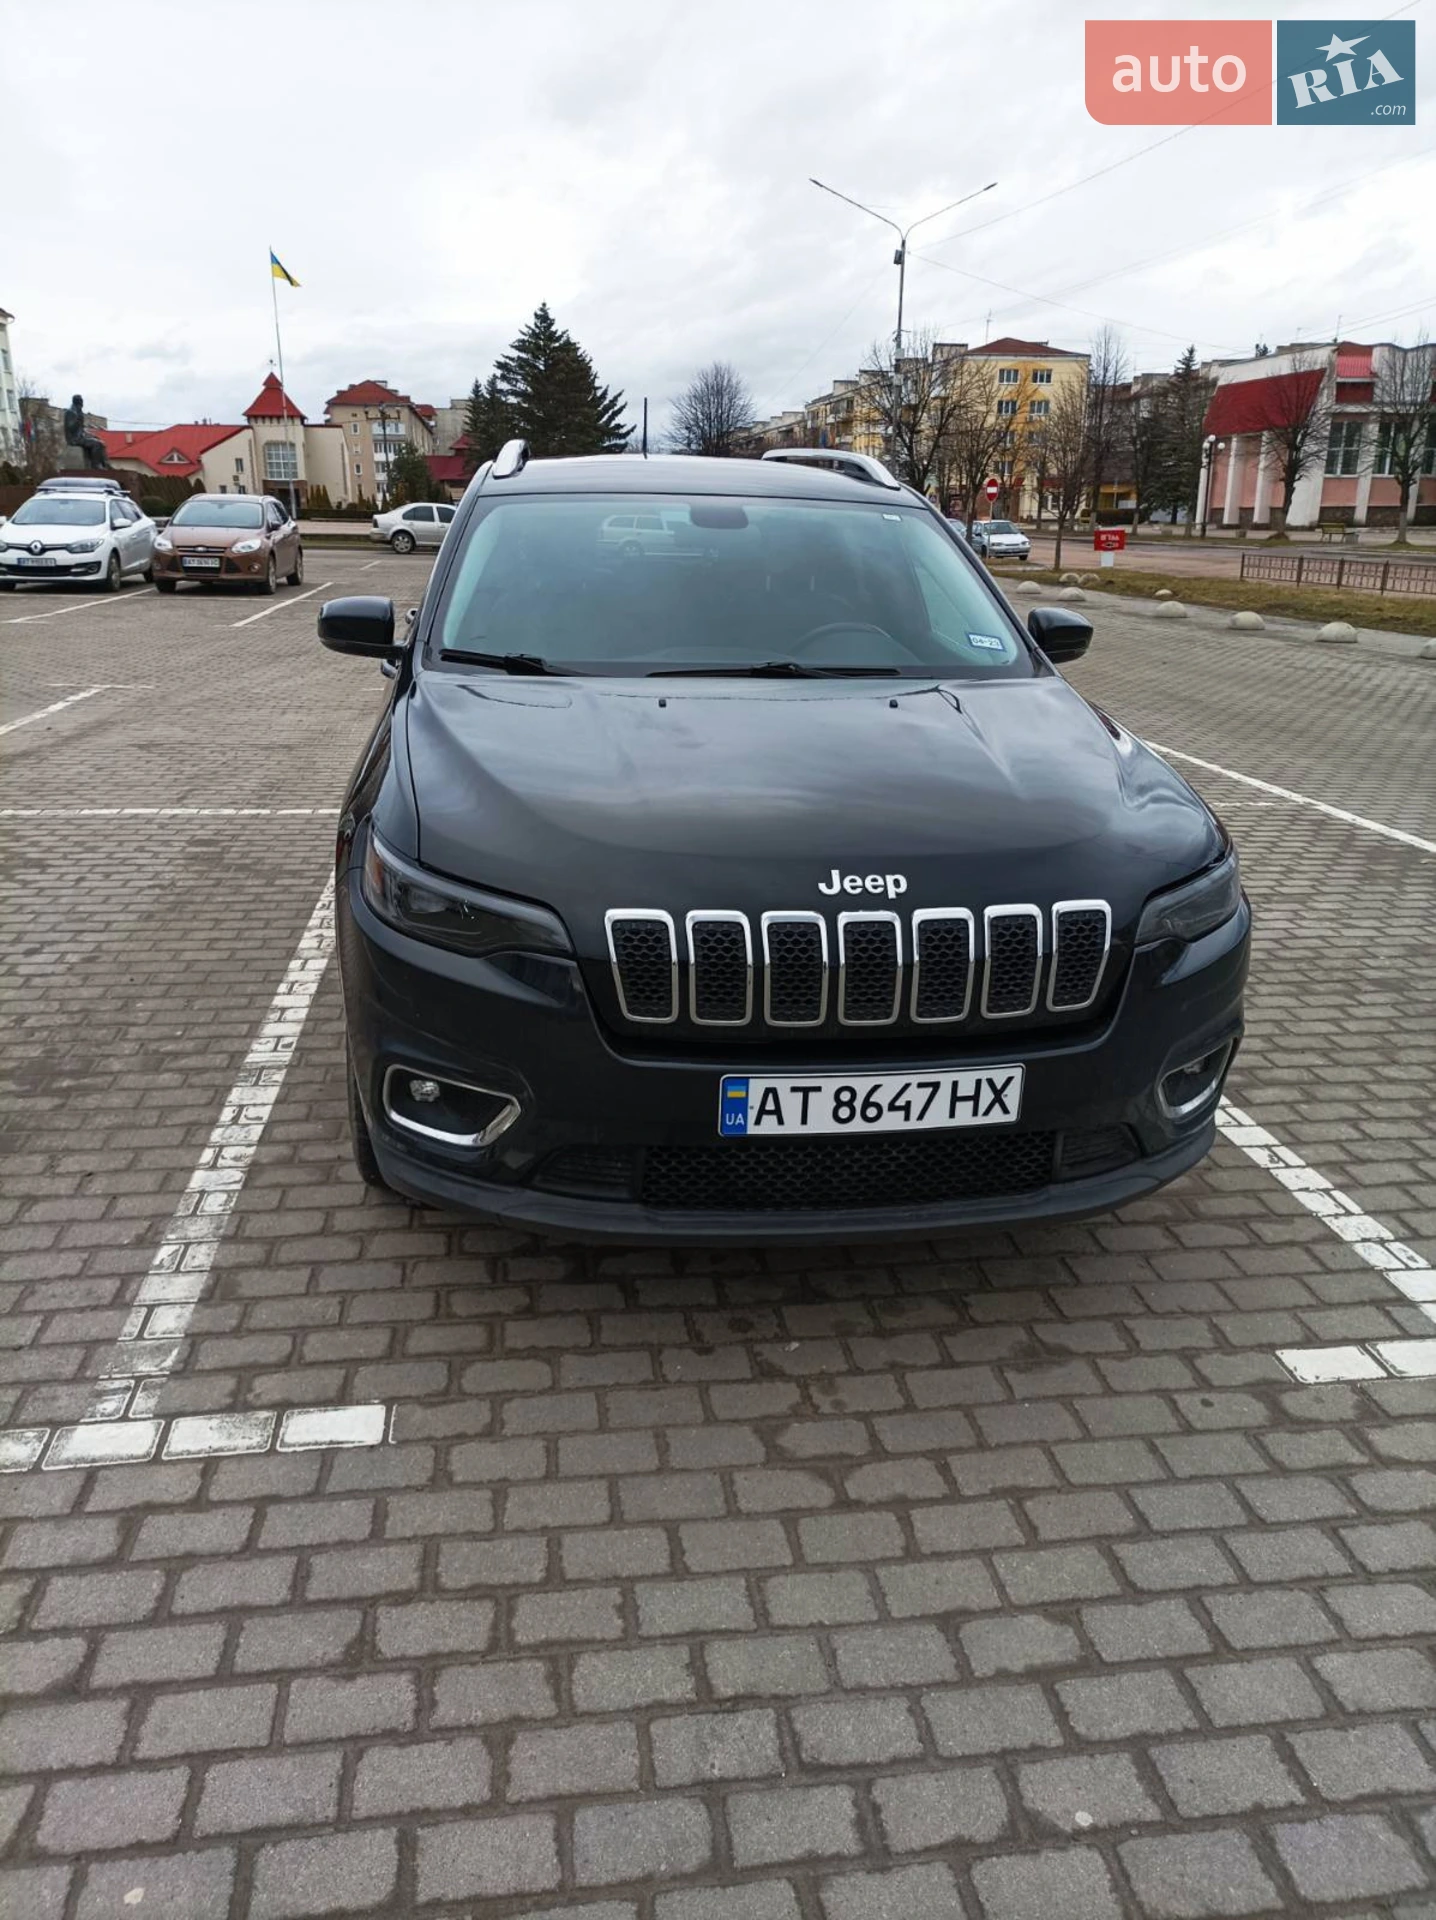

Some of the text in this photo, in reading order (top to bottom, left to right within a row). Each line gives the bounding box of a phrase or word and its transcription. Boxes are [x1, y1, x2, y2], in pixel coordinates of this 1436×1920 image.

[817, 869, 908, 900] Jeep
[753, 1075, 1015, 1126] AT 8647 HX
[725, 1112, 745, 1125] UA
